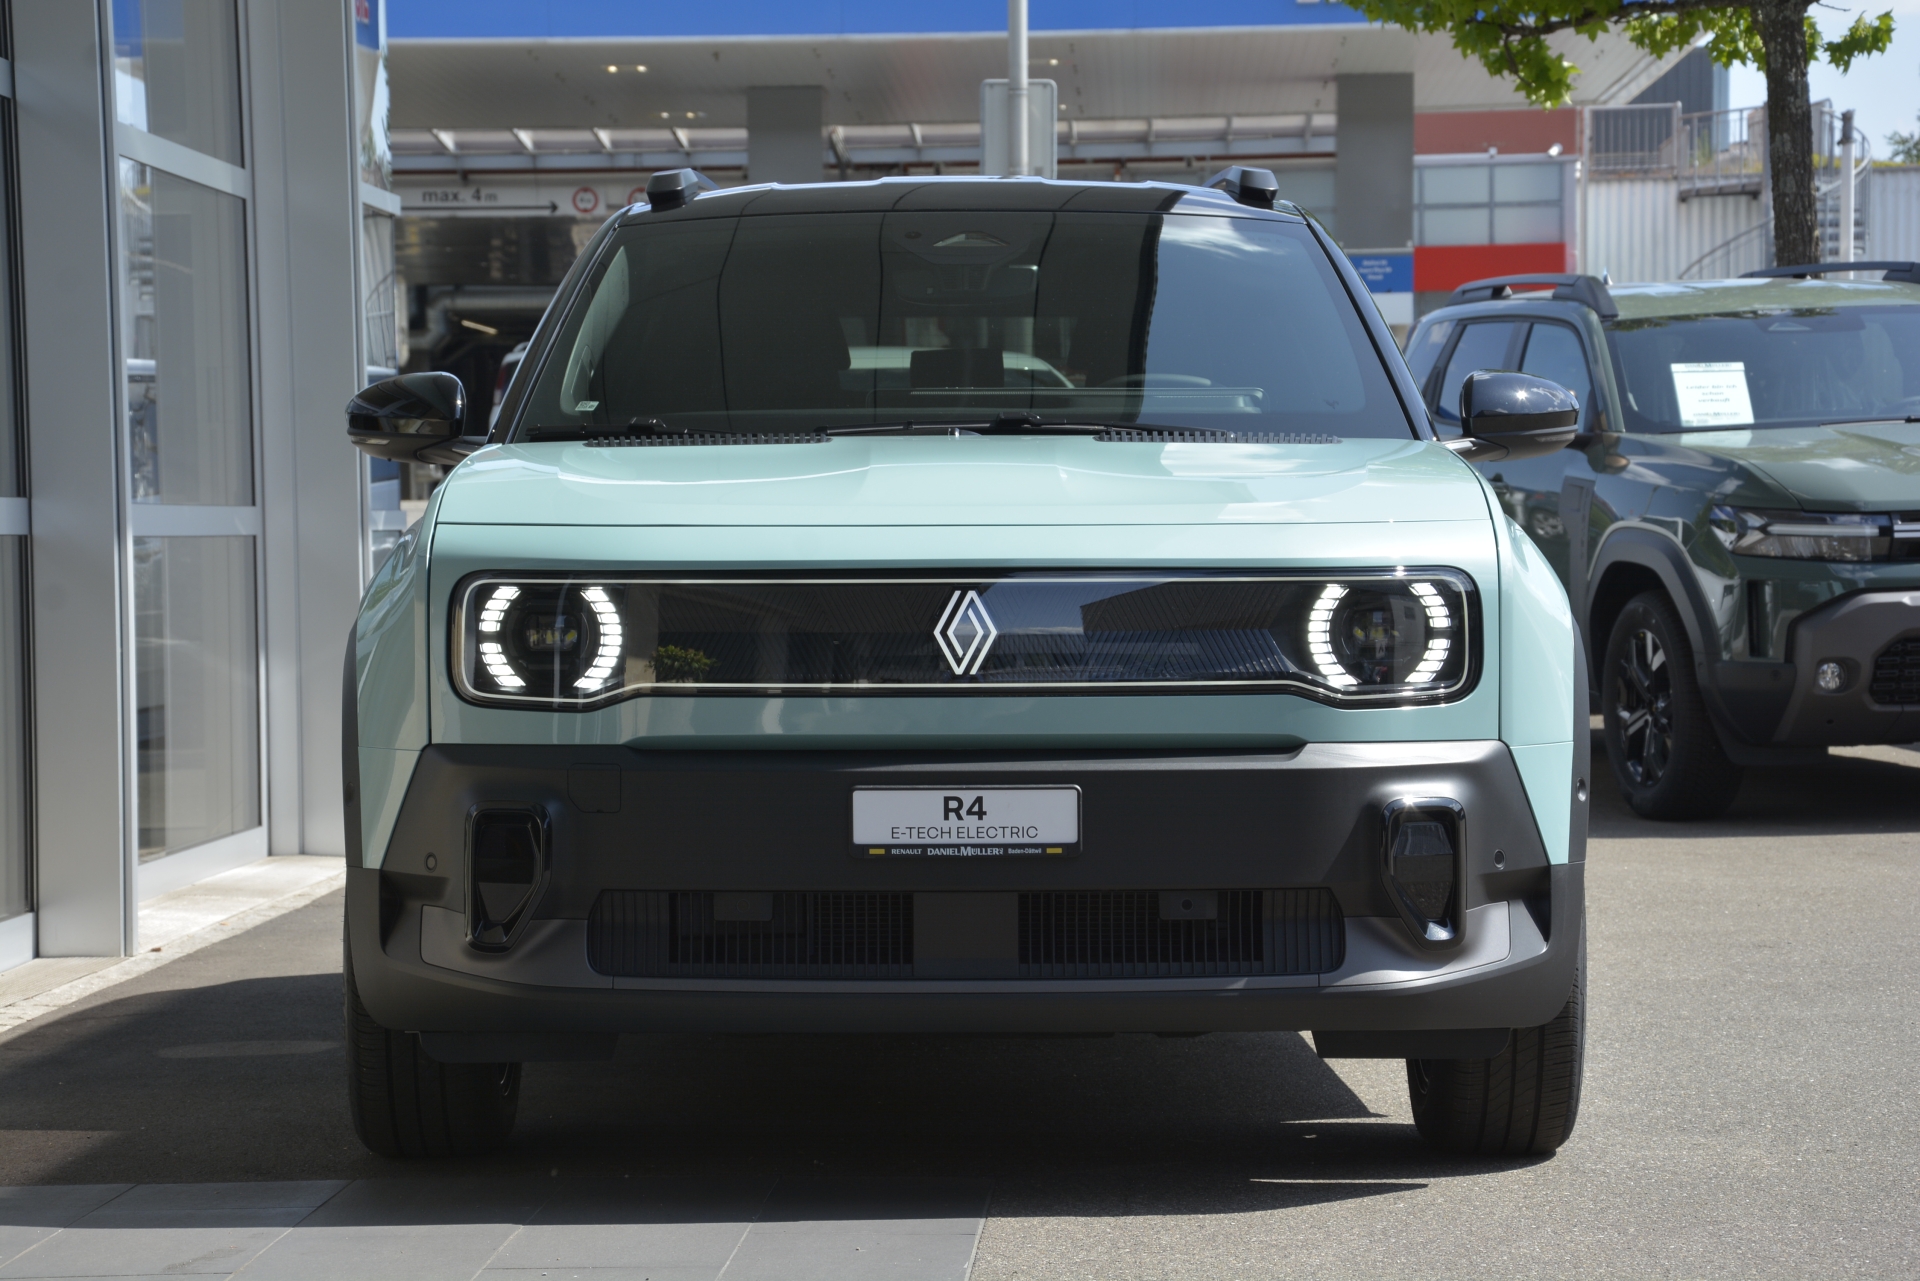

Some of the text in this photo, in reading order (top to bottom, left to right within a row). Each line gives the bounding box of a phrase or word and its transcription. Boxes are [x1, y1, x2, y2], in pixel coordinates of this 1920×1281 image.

[421, 186, 499, 203] max. 4 m
[942, 795, 987, 821] R4
[891, 825, 1039, 839] E-TECH ELECTRIC
